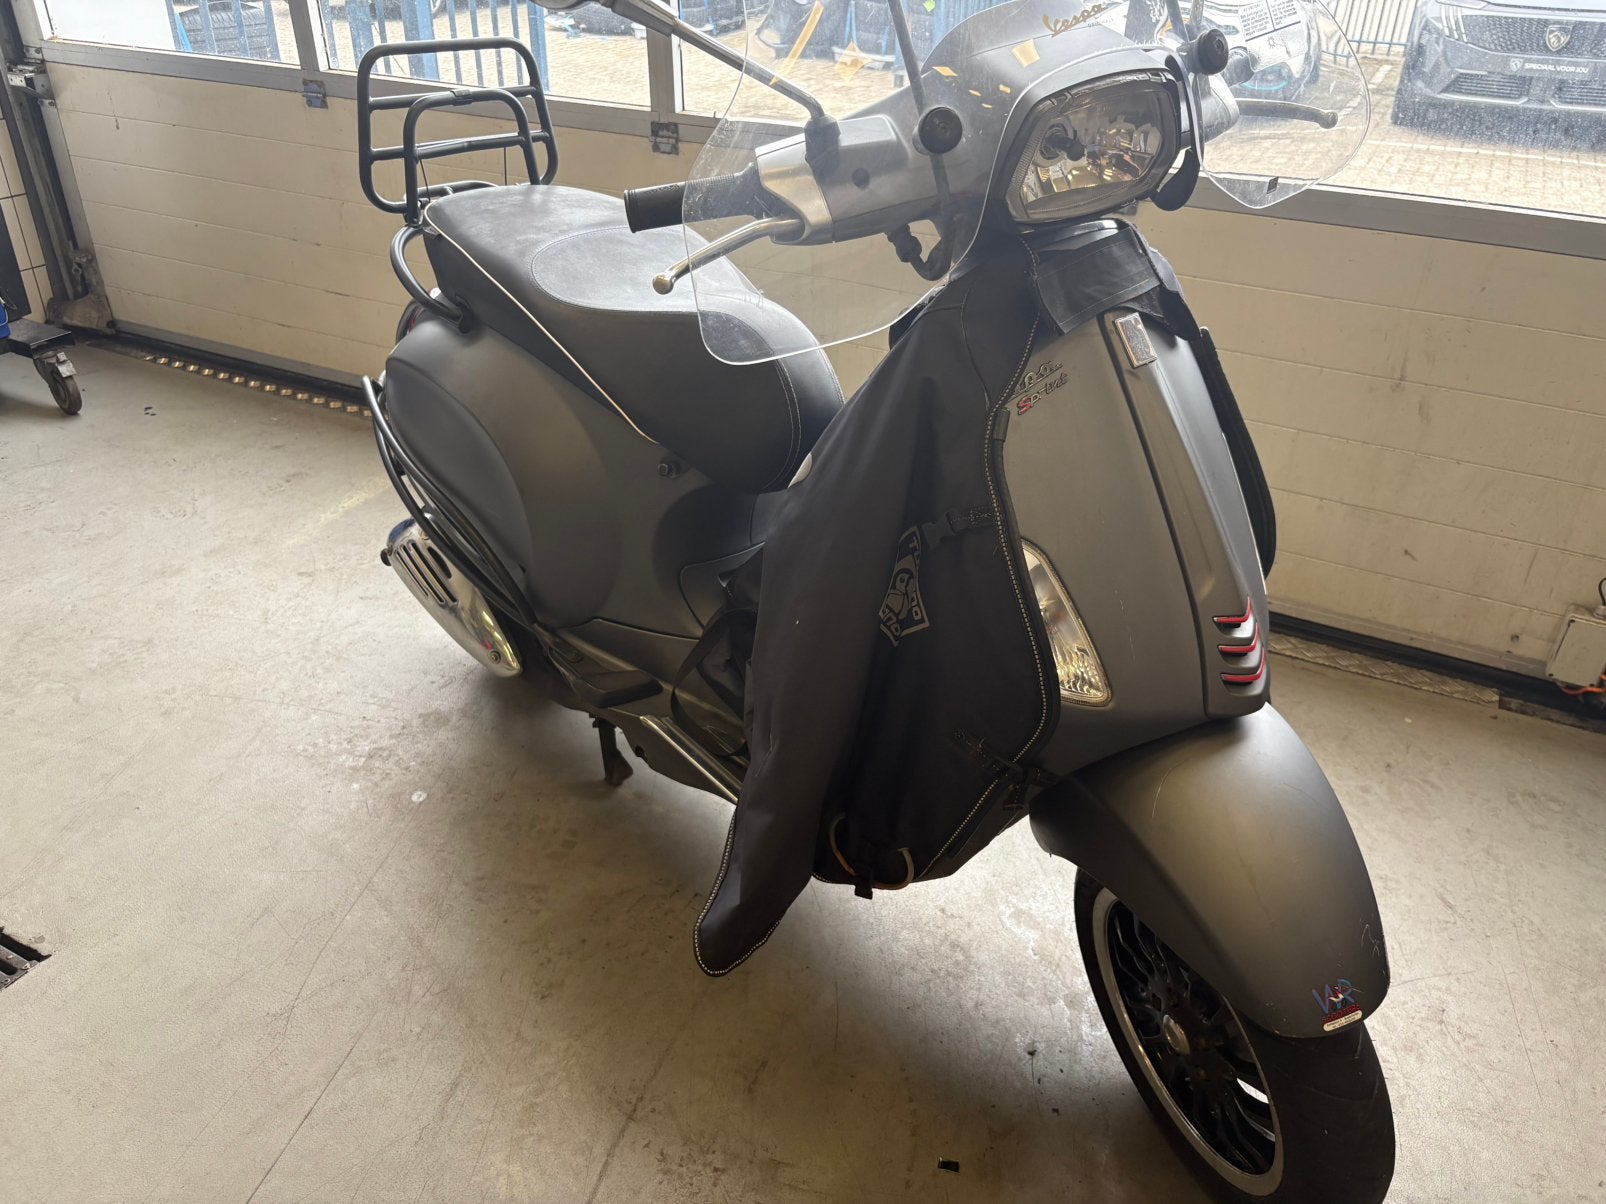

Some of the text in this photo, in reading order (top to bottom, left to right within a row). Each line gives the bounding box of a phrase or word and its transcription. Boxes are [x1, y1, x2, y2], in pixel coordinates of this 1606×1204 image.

[1042, 4, 1108, 38] Vespa
[1556, 65, 1575, 73] VOOR
[1575, 66, 1590, 74] JOU
[1017, 372, 1068, 415] Sprint
